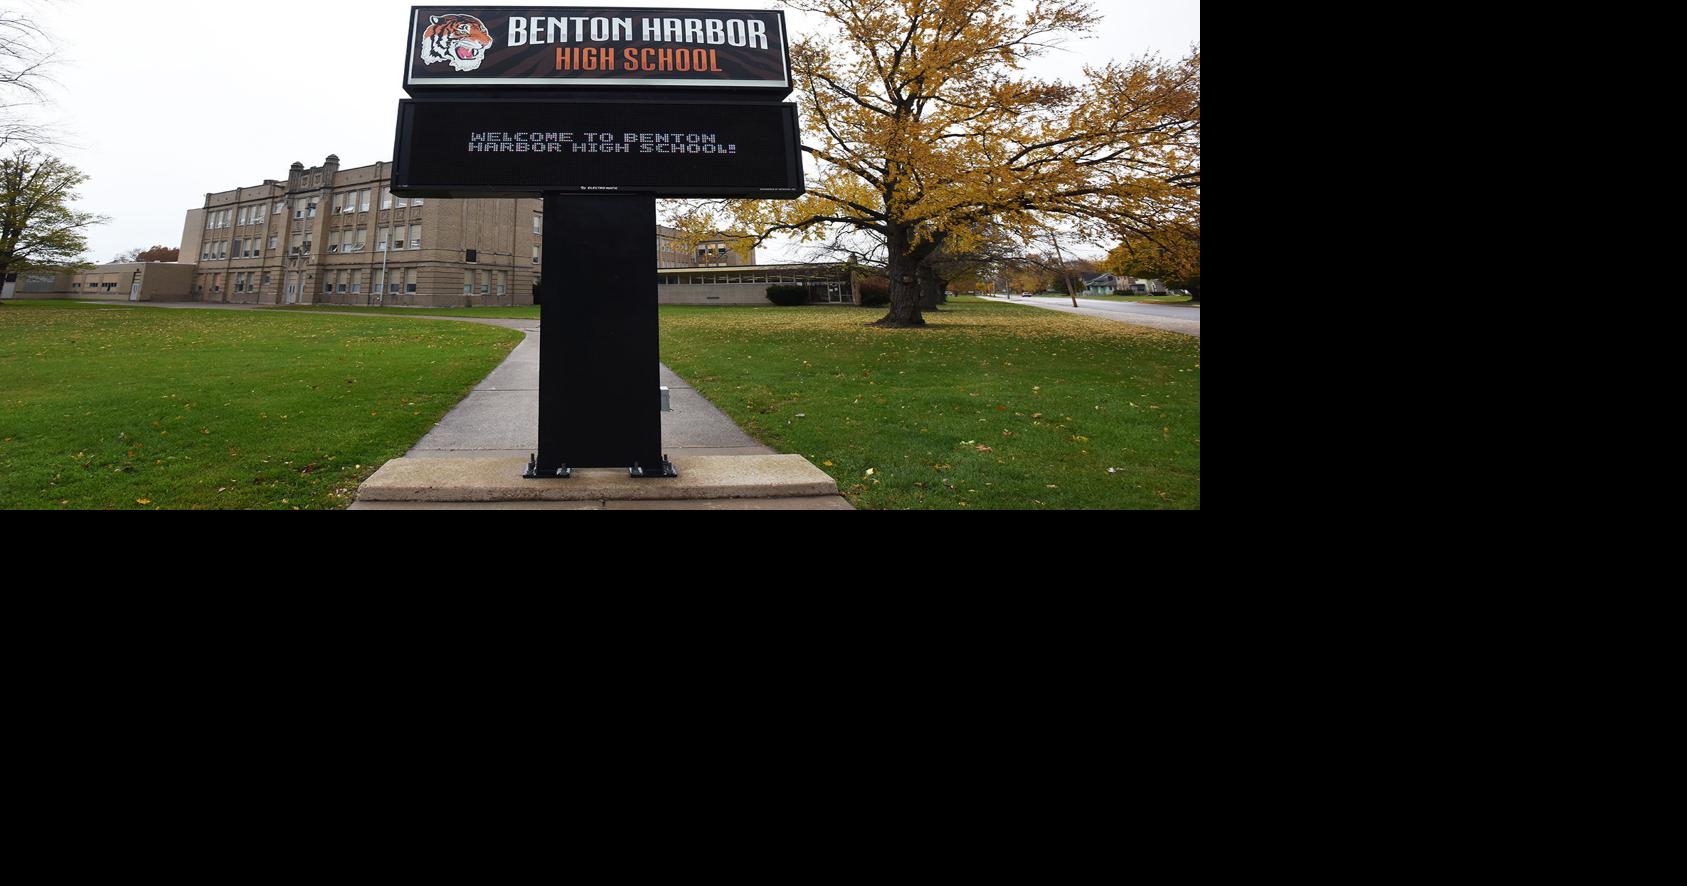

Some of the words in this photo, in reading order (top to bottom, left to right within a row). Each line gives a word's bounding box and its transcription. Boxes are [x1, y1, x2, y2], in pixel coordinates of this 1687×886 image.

[507, 16, 632, 46] BENTON
[642, 17, 769, 50] HARBOR
[555, 47, 615, 71] HIGH
[623, 47, 722, 72] SCHOOL
[471, 132, 574, 142] WELCOME
[583, 132, 614, 143] TO
[623, 133, 716, 144] BENTON
[468, 142, 562, 152] HARBOR
[572, 143, 630, 153] HIGH
[639, 143, 737, 154] SCHOOL!
